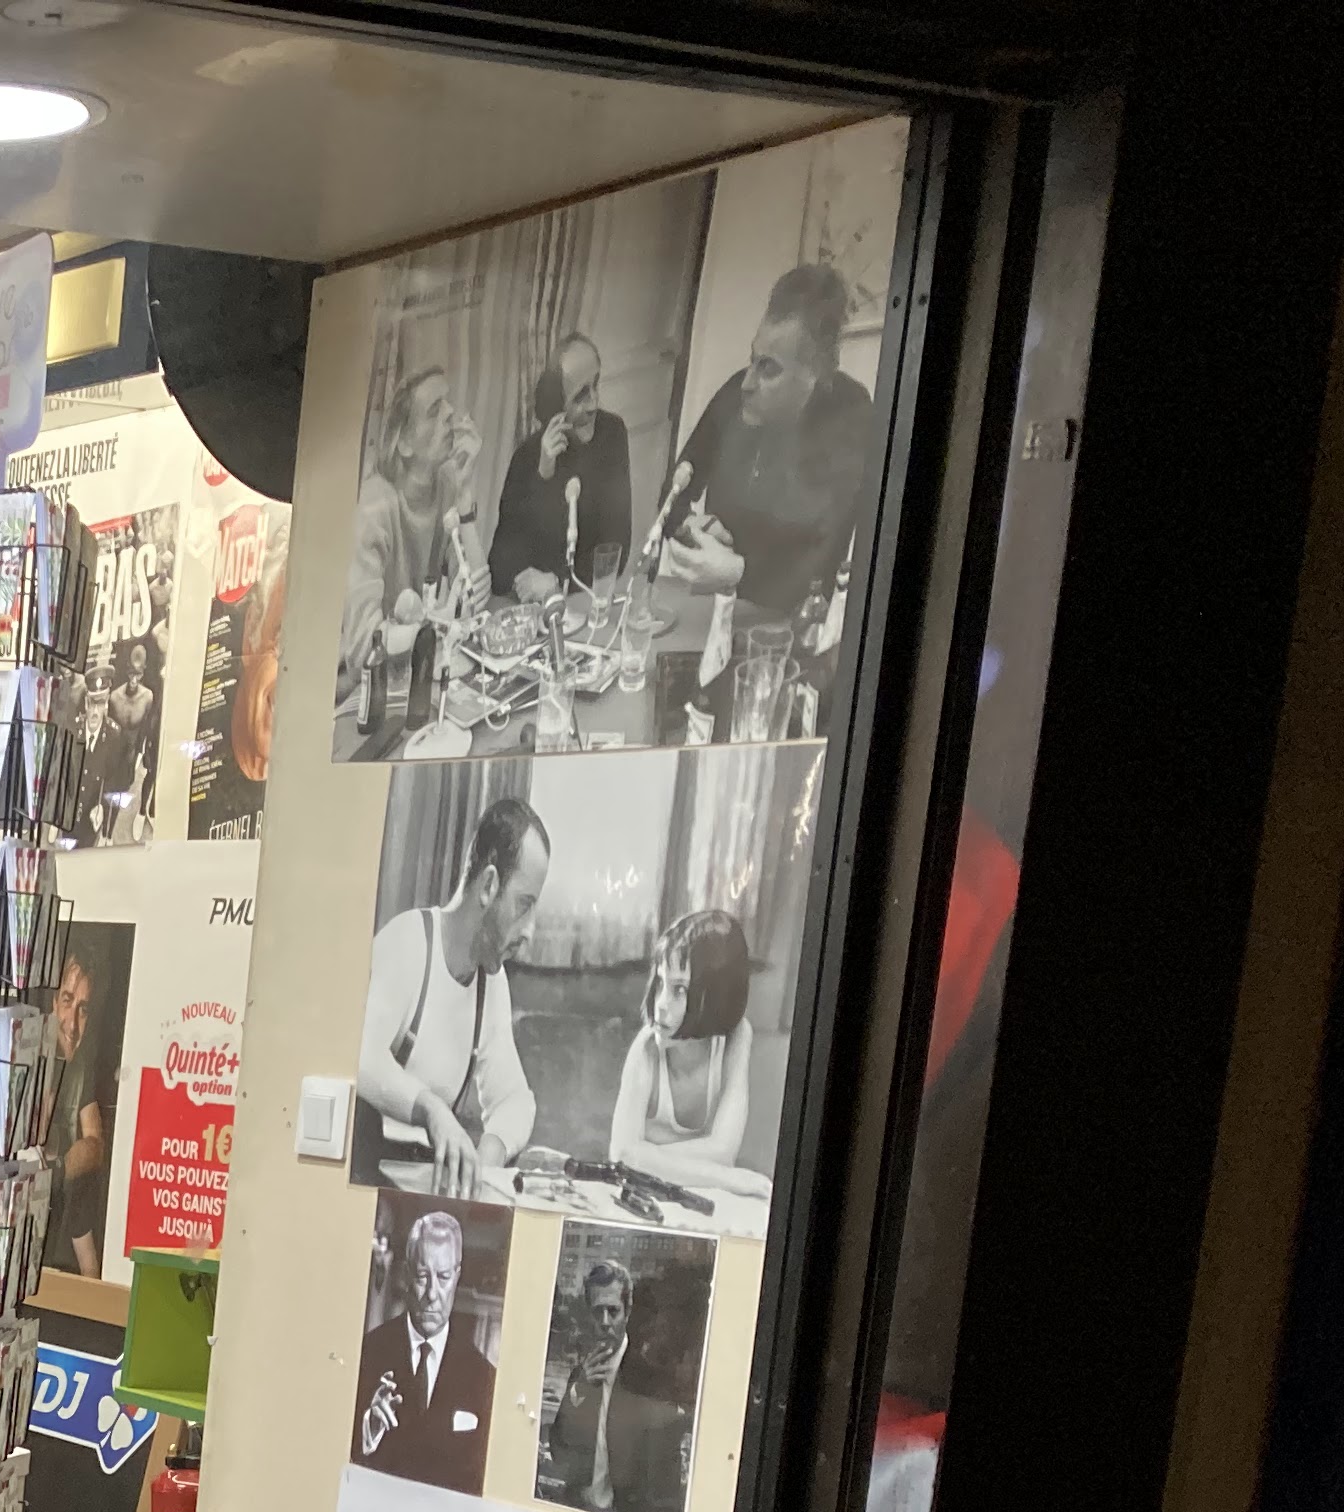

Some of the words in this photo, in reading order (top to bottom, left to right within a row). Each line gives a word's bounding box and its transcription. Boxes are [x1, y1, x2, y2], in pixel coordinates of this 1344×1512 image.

[8, 451, 56, 487] OUTENEZ
[56, 446, 70, 479] LA
[72, 431, 119, 476] LIBERTÉ
[88, 544, 157, 646] BAS
[181, 1001, 237, 1026] NOUVEAU
[165, 1040, 241, 1077] Quinté+
[192, 1078, 232, 1096] option
[161, 1137, 199, 1160] POUR
[138, 1160, 175, 1183] VOUS
[177, 1164, 229, 1191] POUVEZ
[152, 1187, 180, 1208] VOS
[158, 1214, 215, 1243] JUSQU'À
